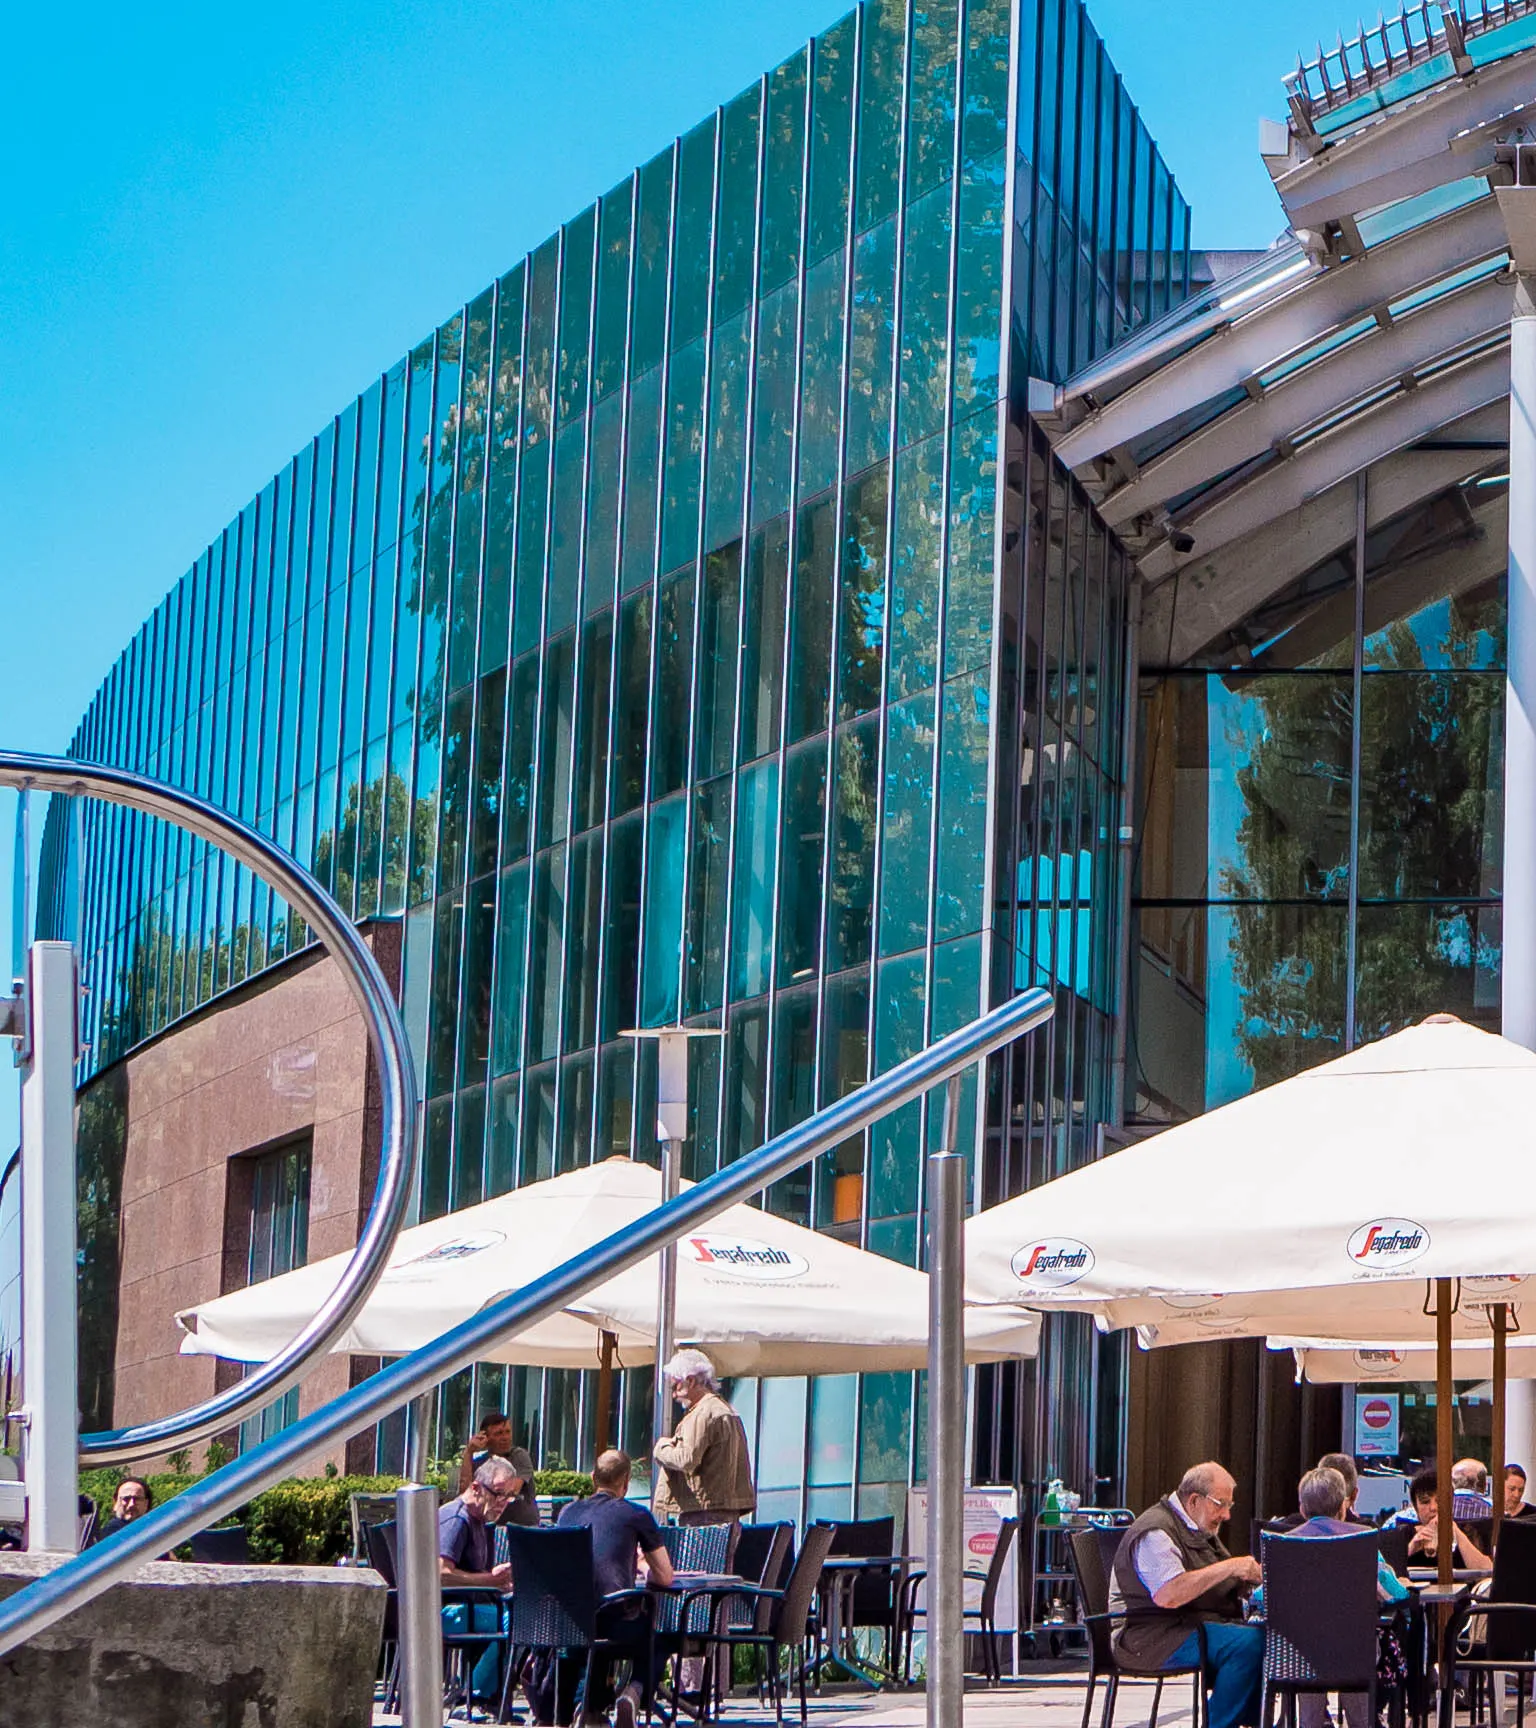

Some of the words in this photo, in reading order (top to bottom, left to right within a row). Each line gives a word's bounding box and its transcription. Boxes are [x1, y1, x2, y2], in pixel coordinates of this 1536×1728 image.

[689, 1238, 791, 1265] Segafredo
[1355, 1226, 1423, 1258] Segafredo
[1019, 1245, 1088, 1276] Segafredo
